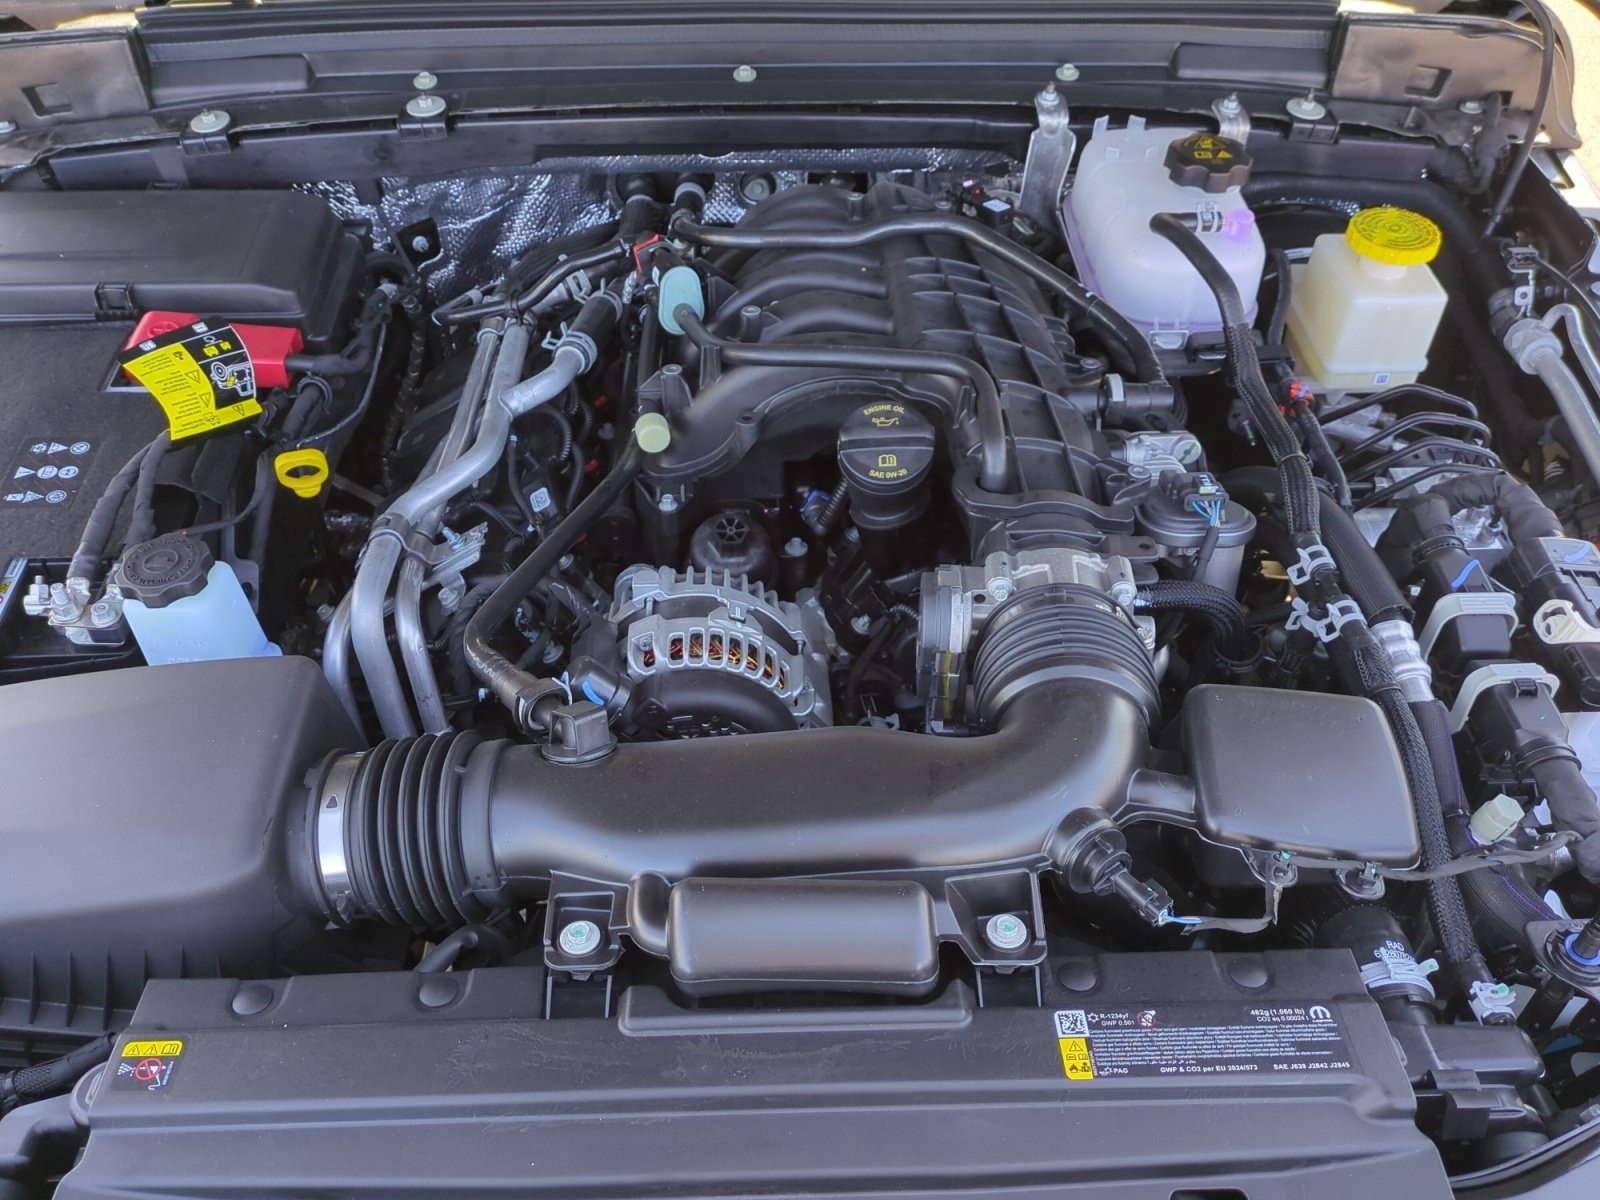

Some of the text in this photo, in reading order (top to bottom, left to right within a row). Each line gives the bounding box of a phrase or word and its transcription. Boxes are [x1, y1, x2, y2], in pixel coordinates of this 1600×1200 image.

[863, 404, 905, 416] ENGINE OIL
[868, 468, 908, 479] SAE 0W-20
[1385, 940, 1405, 952] RAD
[1250, 1008, 1269, 1017] 482g
